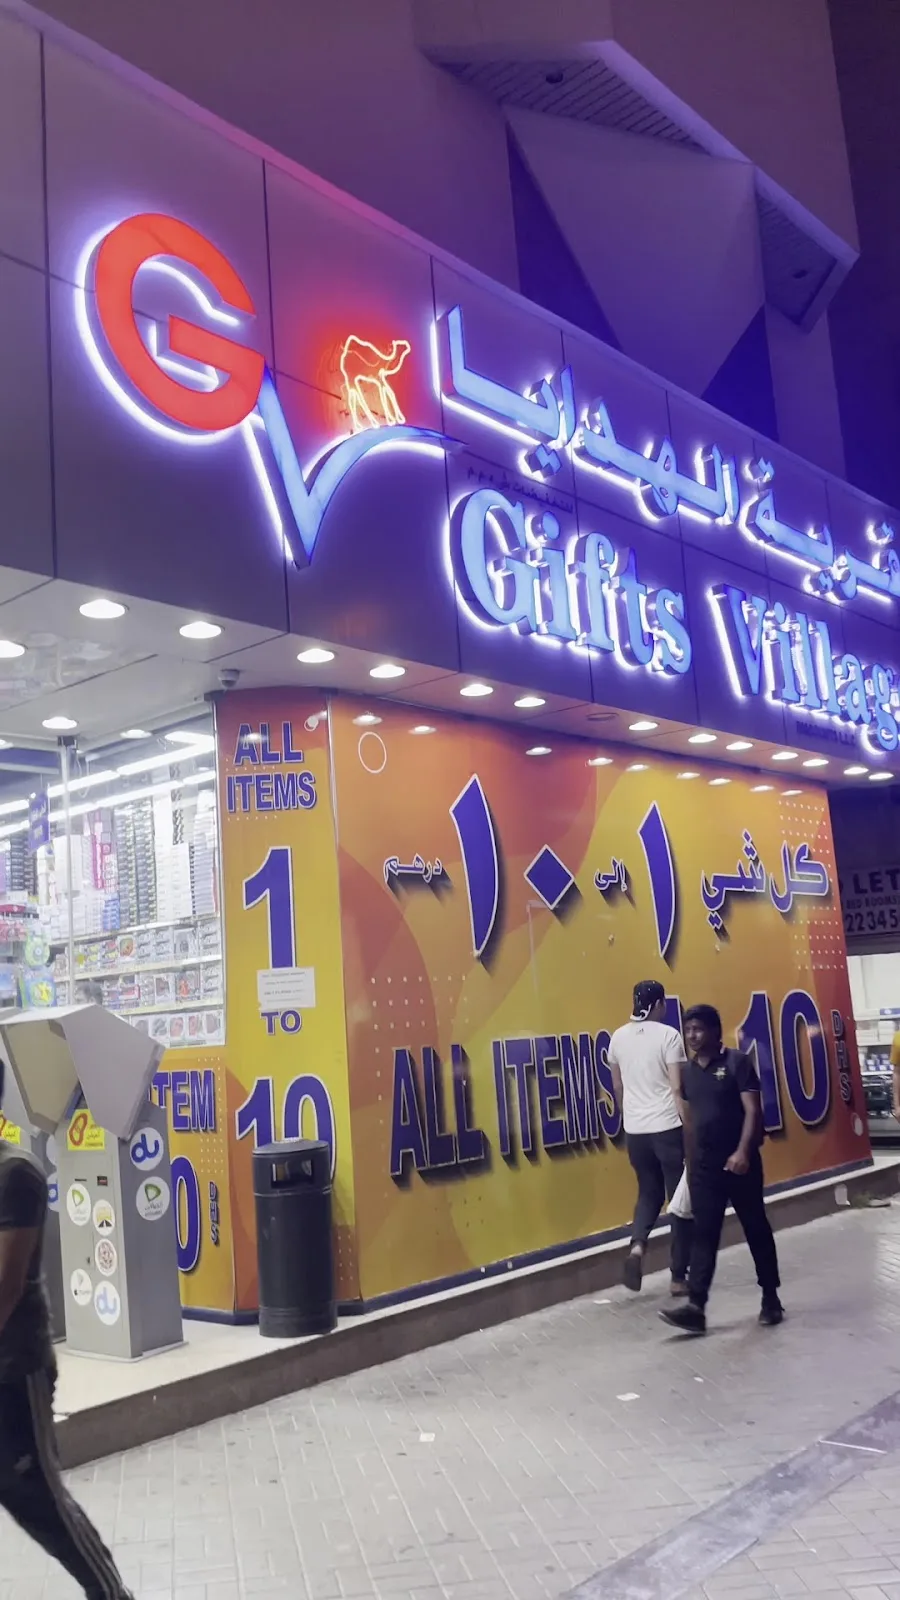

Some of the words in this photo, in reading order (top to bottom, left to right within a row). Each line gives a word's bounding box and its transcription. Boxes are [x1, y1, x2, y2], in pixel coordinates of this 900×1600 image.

[442, 304, 738, 522] الهدايا
[455, 488, 692, 675] Gifts
[716, 583, 900, 751] Villag
[234, 721, 304, 766] ALL
[226, 771, 316, 812] ITEMS
[384, 853, 442, 883] درهم
[701, 828, 765, 930] شي
[769, 840, 829, 913] كل
[853, 868, 900, 894] LET
[243, 846, 296, 969] 1
[261, 1010, 302, 1035] TO
[389, 1043, 484, 1175] ALL
[492, 1030, 622, 1155] ITEMS
[736, 989, 829, 1131] 10
[831, 1009, 852, 1102] DHS
[149, 1068, 215, 1132] TEM
[131, 1133, 160, 1163] du
[97, 1286, 117, 1315] du
